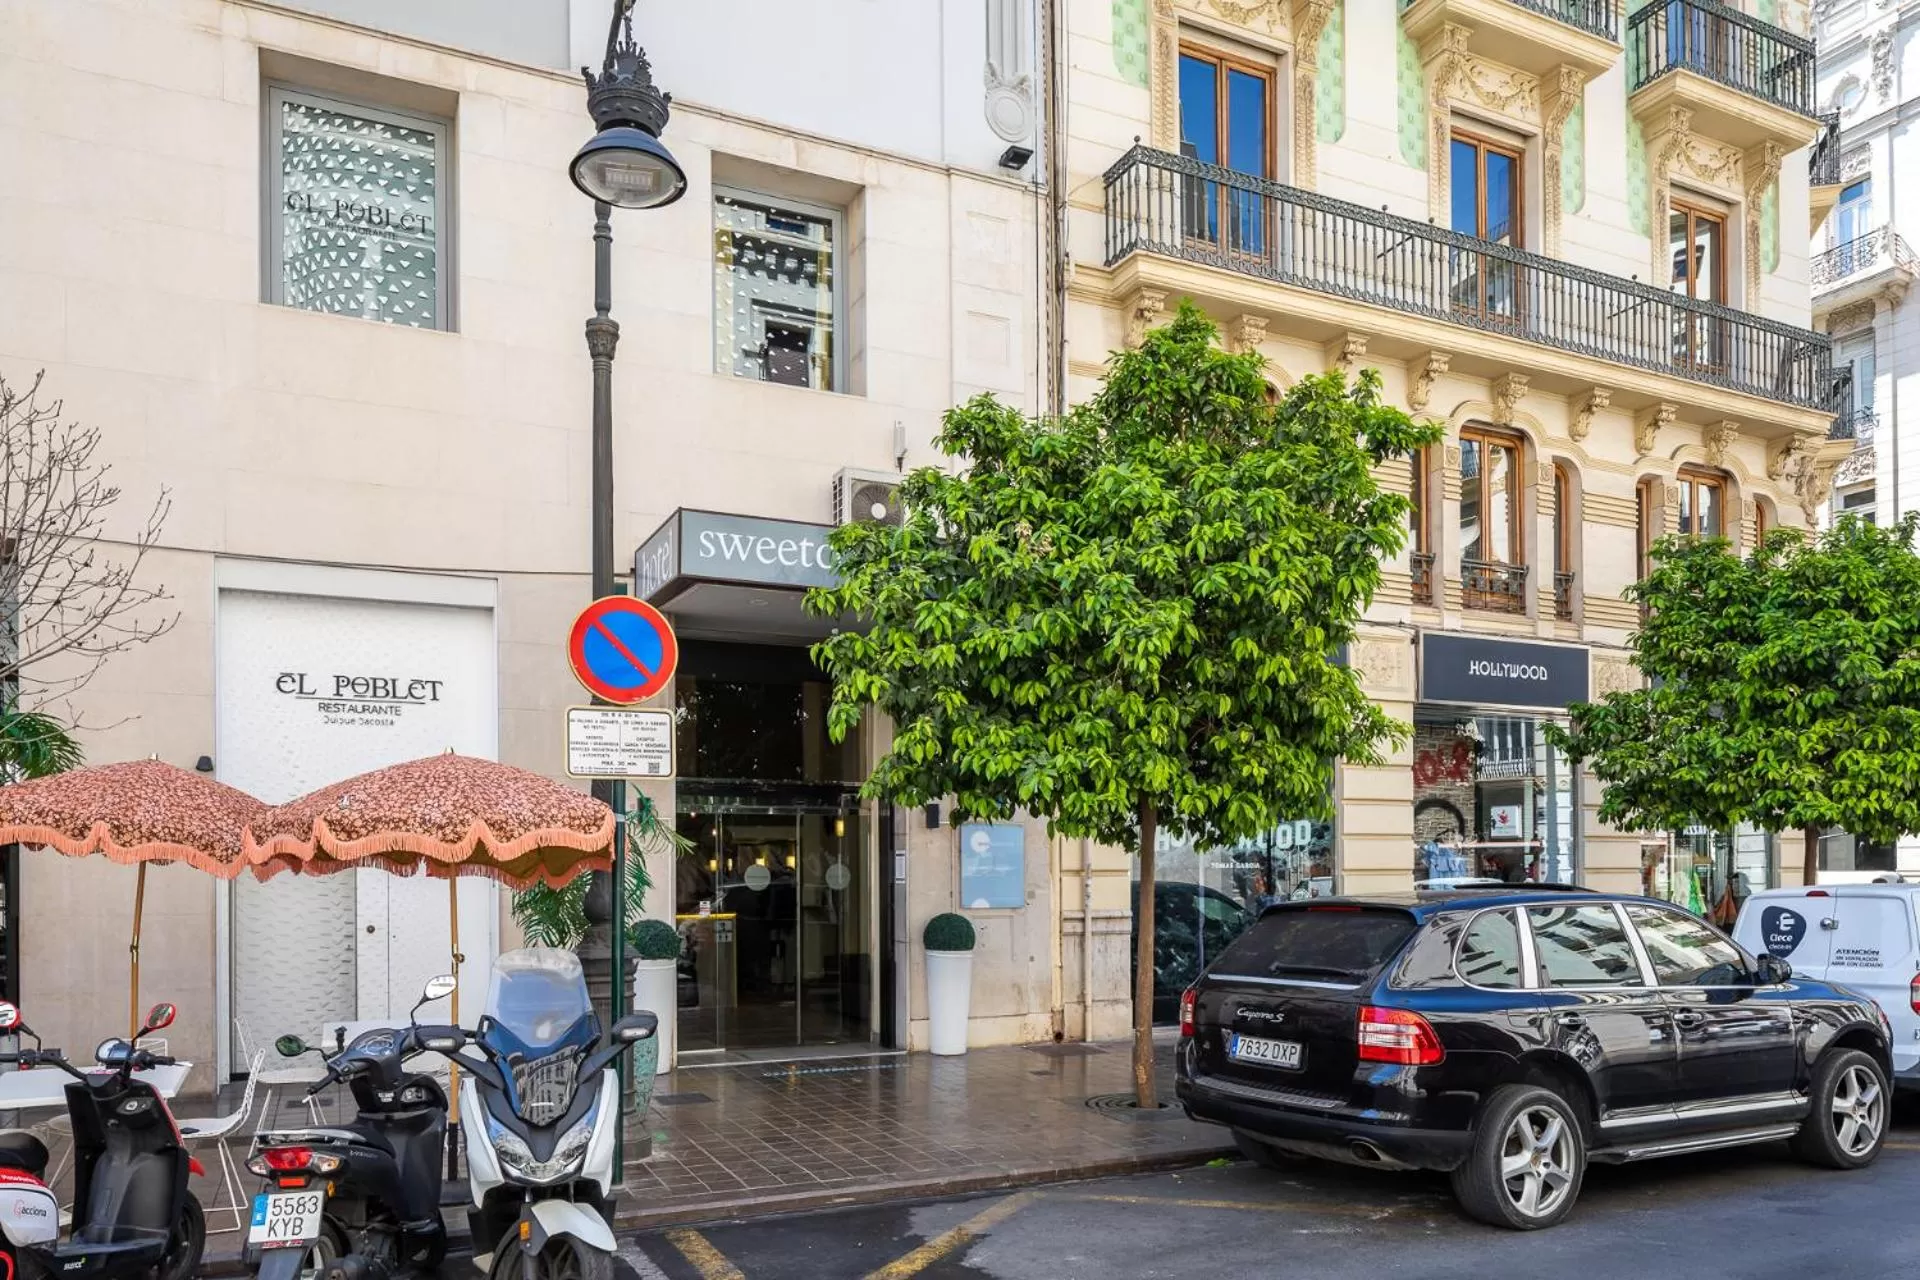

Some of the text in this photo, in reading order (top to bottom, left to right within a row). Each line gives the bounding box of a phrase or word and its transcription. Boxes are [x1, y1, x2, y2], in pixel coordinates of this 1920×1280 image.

[641, 528, 673, 599] hotel
[1468, 660, 1548, 681] HOLLYWOOD
[276, 672, 444, 701] EL POBLET
[318, 702, 402, 716] RESTAURANTE
[1769, 933, 1793, 942] Clece
[1238, 1038, 1298, 1063] 7632 DXP
[21, 1205, 47, 1217] acciona
[271, 1195, 319, 1217] 5583
[267, 1217, 304, 1237] KYB
